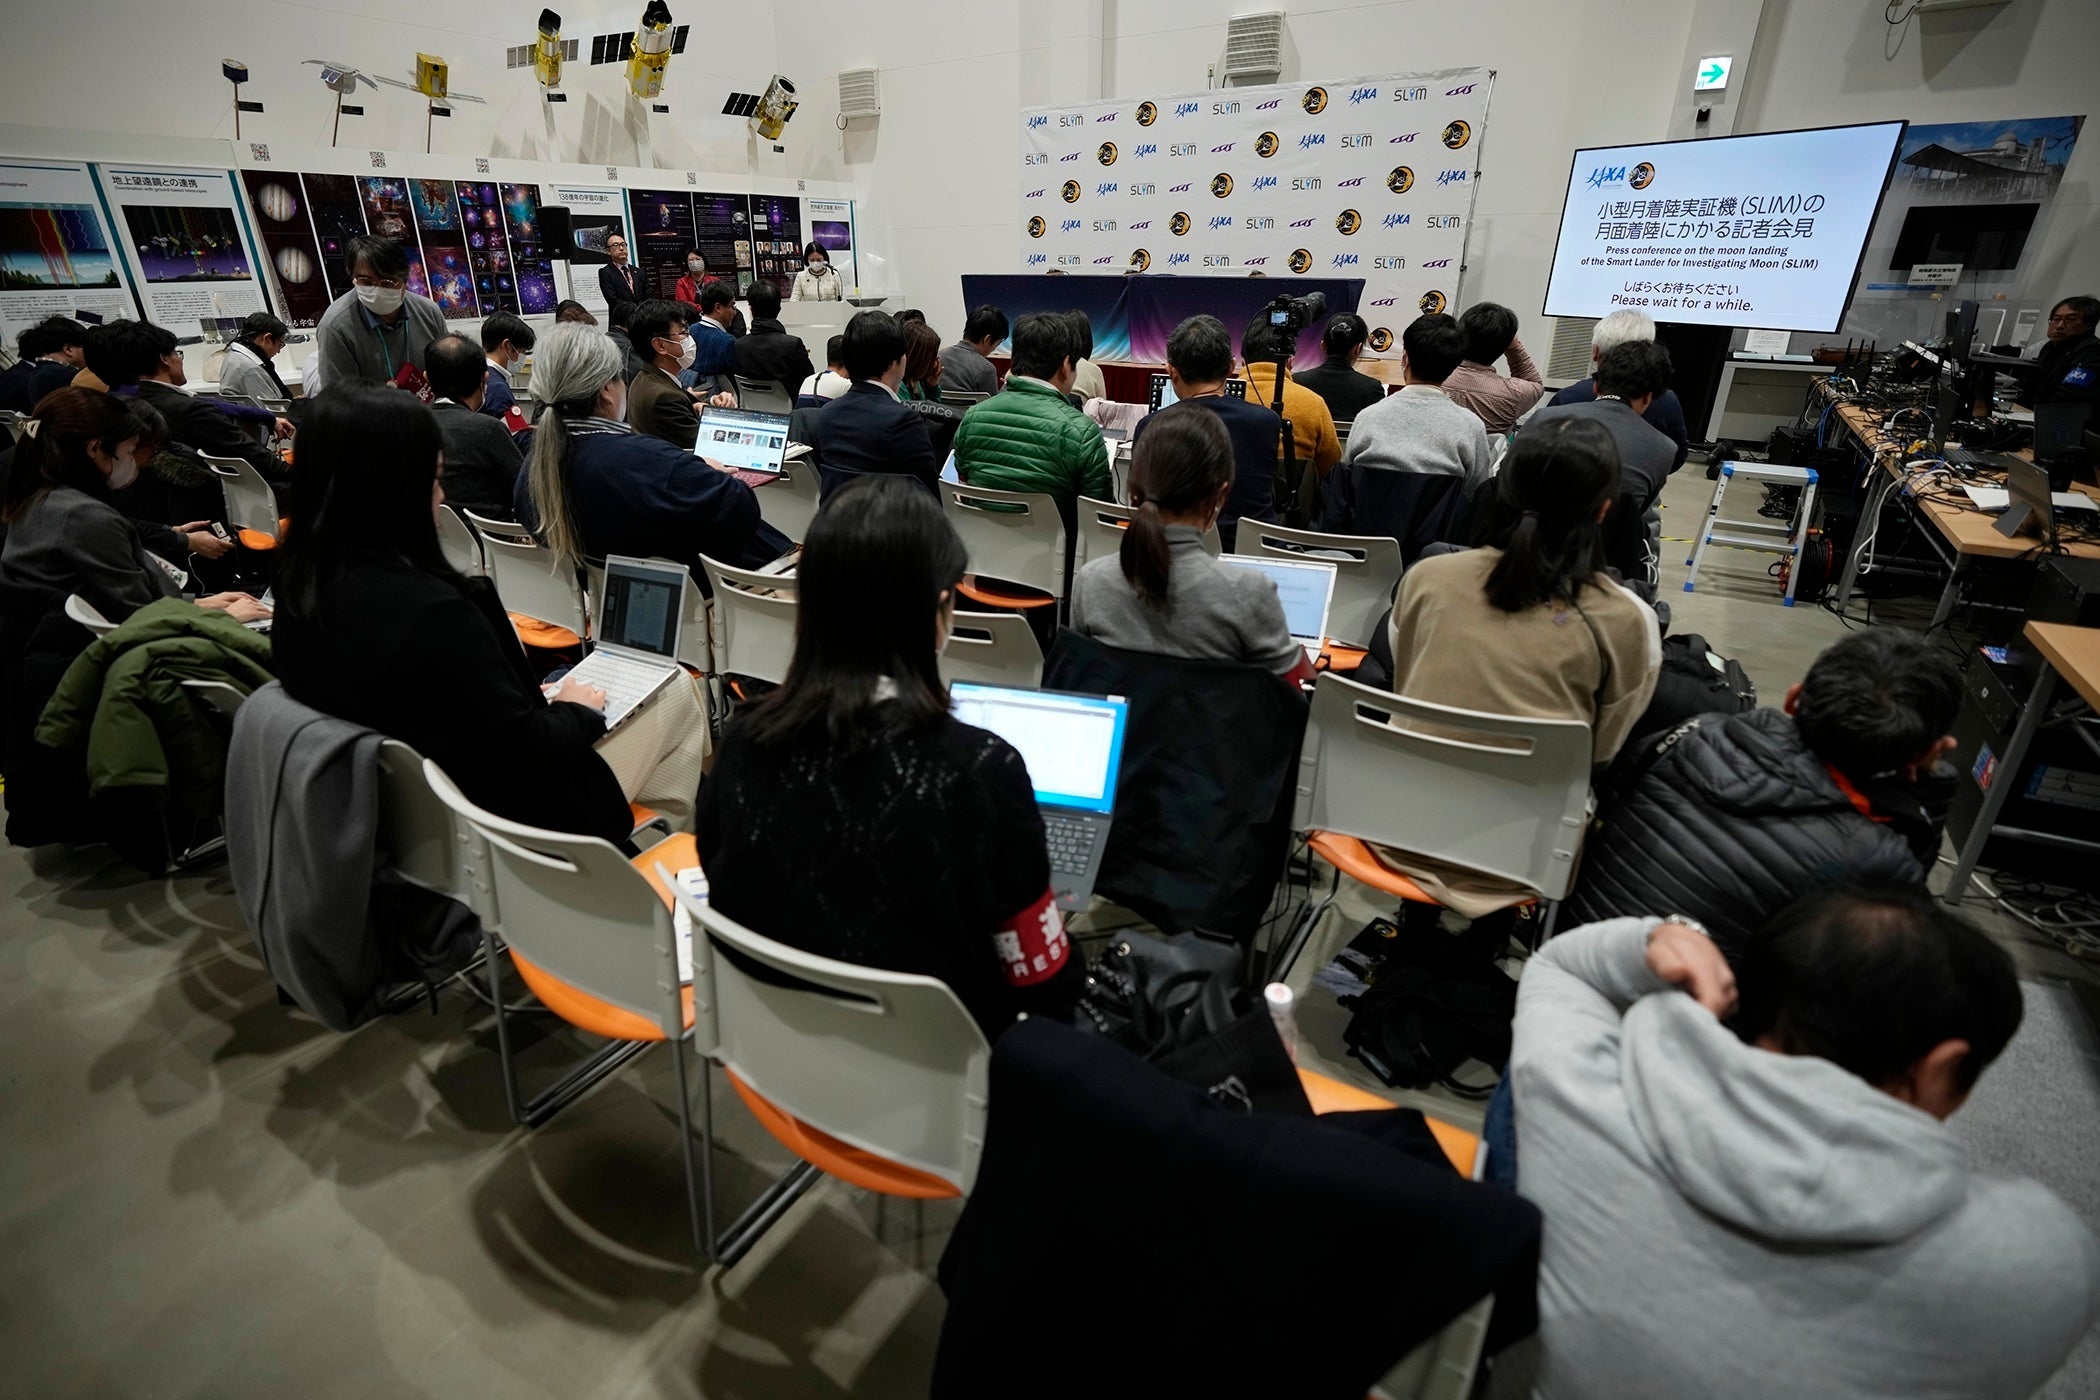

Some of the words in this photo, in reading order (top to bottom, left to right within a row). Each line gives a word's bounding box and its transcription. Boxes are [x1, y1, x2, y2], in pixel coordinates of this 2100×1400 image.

[1349, 88, 1377, 106] JAXA
[1175, 102, 1199, 119] JAXA
[1027, 115, 1049, 130] JAXA
[1299, 134, 1326, 150] JAXA
[1135, 144, 1158, 160] JAXA
[1252, 176, 1277, 193] JAXA
[1436, 169, 1466, 188] JAXA
[1586, 166, 1626, 190] JAXA
[1097, 183, 1119, 197] JAXA
[1061, 219, 1081, 233] JAXA
[1209, 216, 1232, 231] JAXA
[1382, 213, 1410, 230] JAXA
[1594, 218, 1815, 241] 月面着陸にかかる記者会見
[1168, 252, 1190, 267] JAXA
[1605, 246, 1629, 255] Press
[1631, 246, 1682, 255] conference
[1699, 246, 1715, 255] the
[1748, 246, 1789, 258] landing
[1027, 254, 1048, 267] JAXA
[1332, 254, 1359, 270] JAXA
[1581, 257, 1591, 266] of
[1591, 257, 1605, 266] the
[1606, 257, 1632, 267] Smart
[1634, 258, 1666, 267] Lander
[1667, 258, 1681, 267] for
[1682, 258, 1747, 271] Investigating
[1749, 259, 1779, 269] Moon
[1781, 259, 1819, 271] (SLIM)
[1624, 281, 1739, 296] しばらくお待ちください
[1611, 294, 1650, 307] Please
[1652, 297, 1679, 308] wait
[1681, 297, 1702, 309] for
[1704, 301, 1712, 310] a
[1715, 298, 1754, 312] while.
[1656, 719, 1701, 754] SONY
